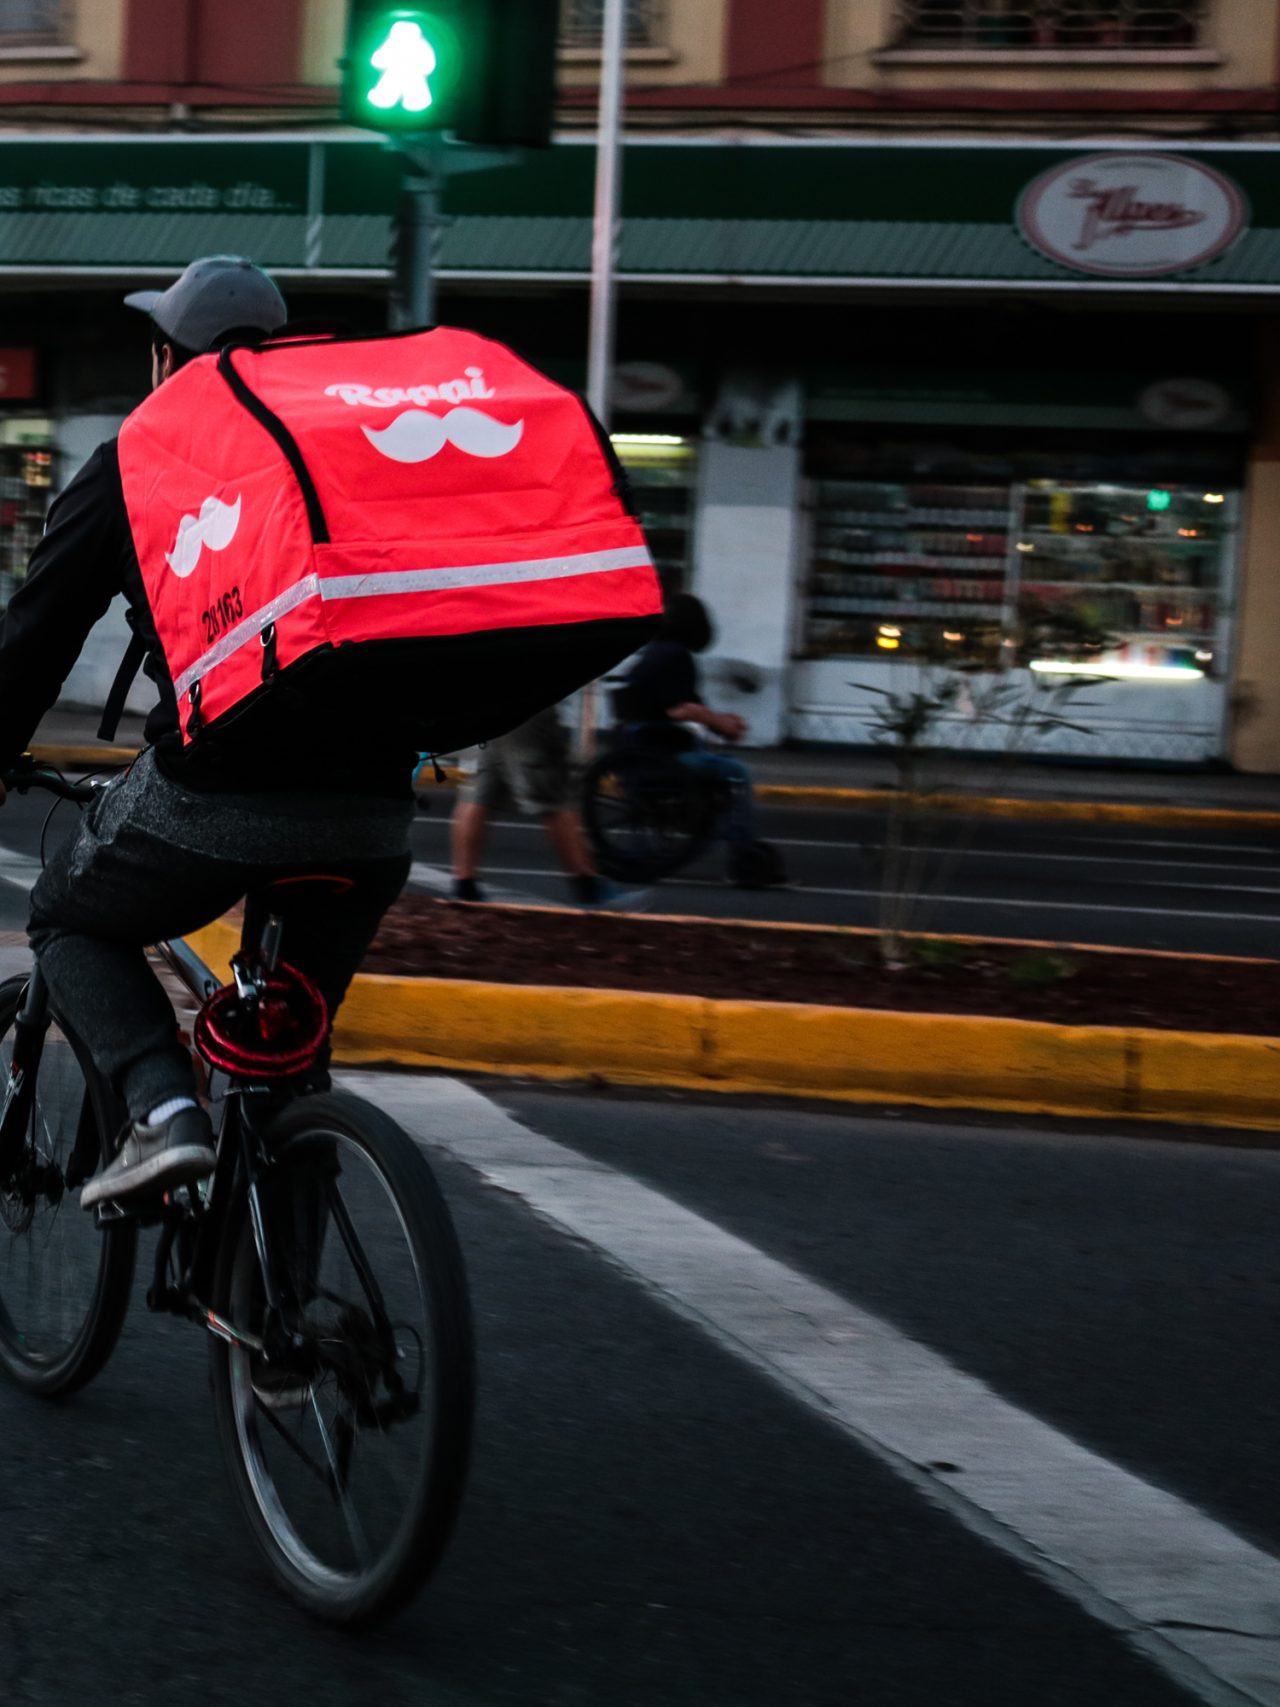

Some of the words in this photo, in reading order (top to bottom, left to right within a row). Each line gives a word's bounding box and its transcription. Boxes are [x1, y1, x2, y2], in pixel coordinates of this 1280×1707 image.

[102, 181, 142, 207] de
[324, 366, 496, 408] Rappi
[201, 585, 243, 645] 28163
